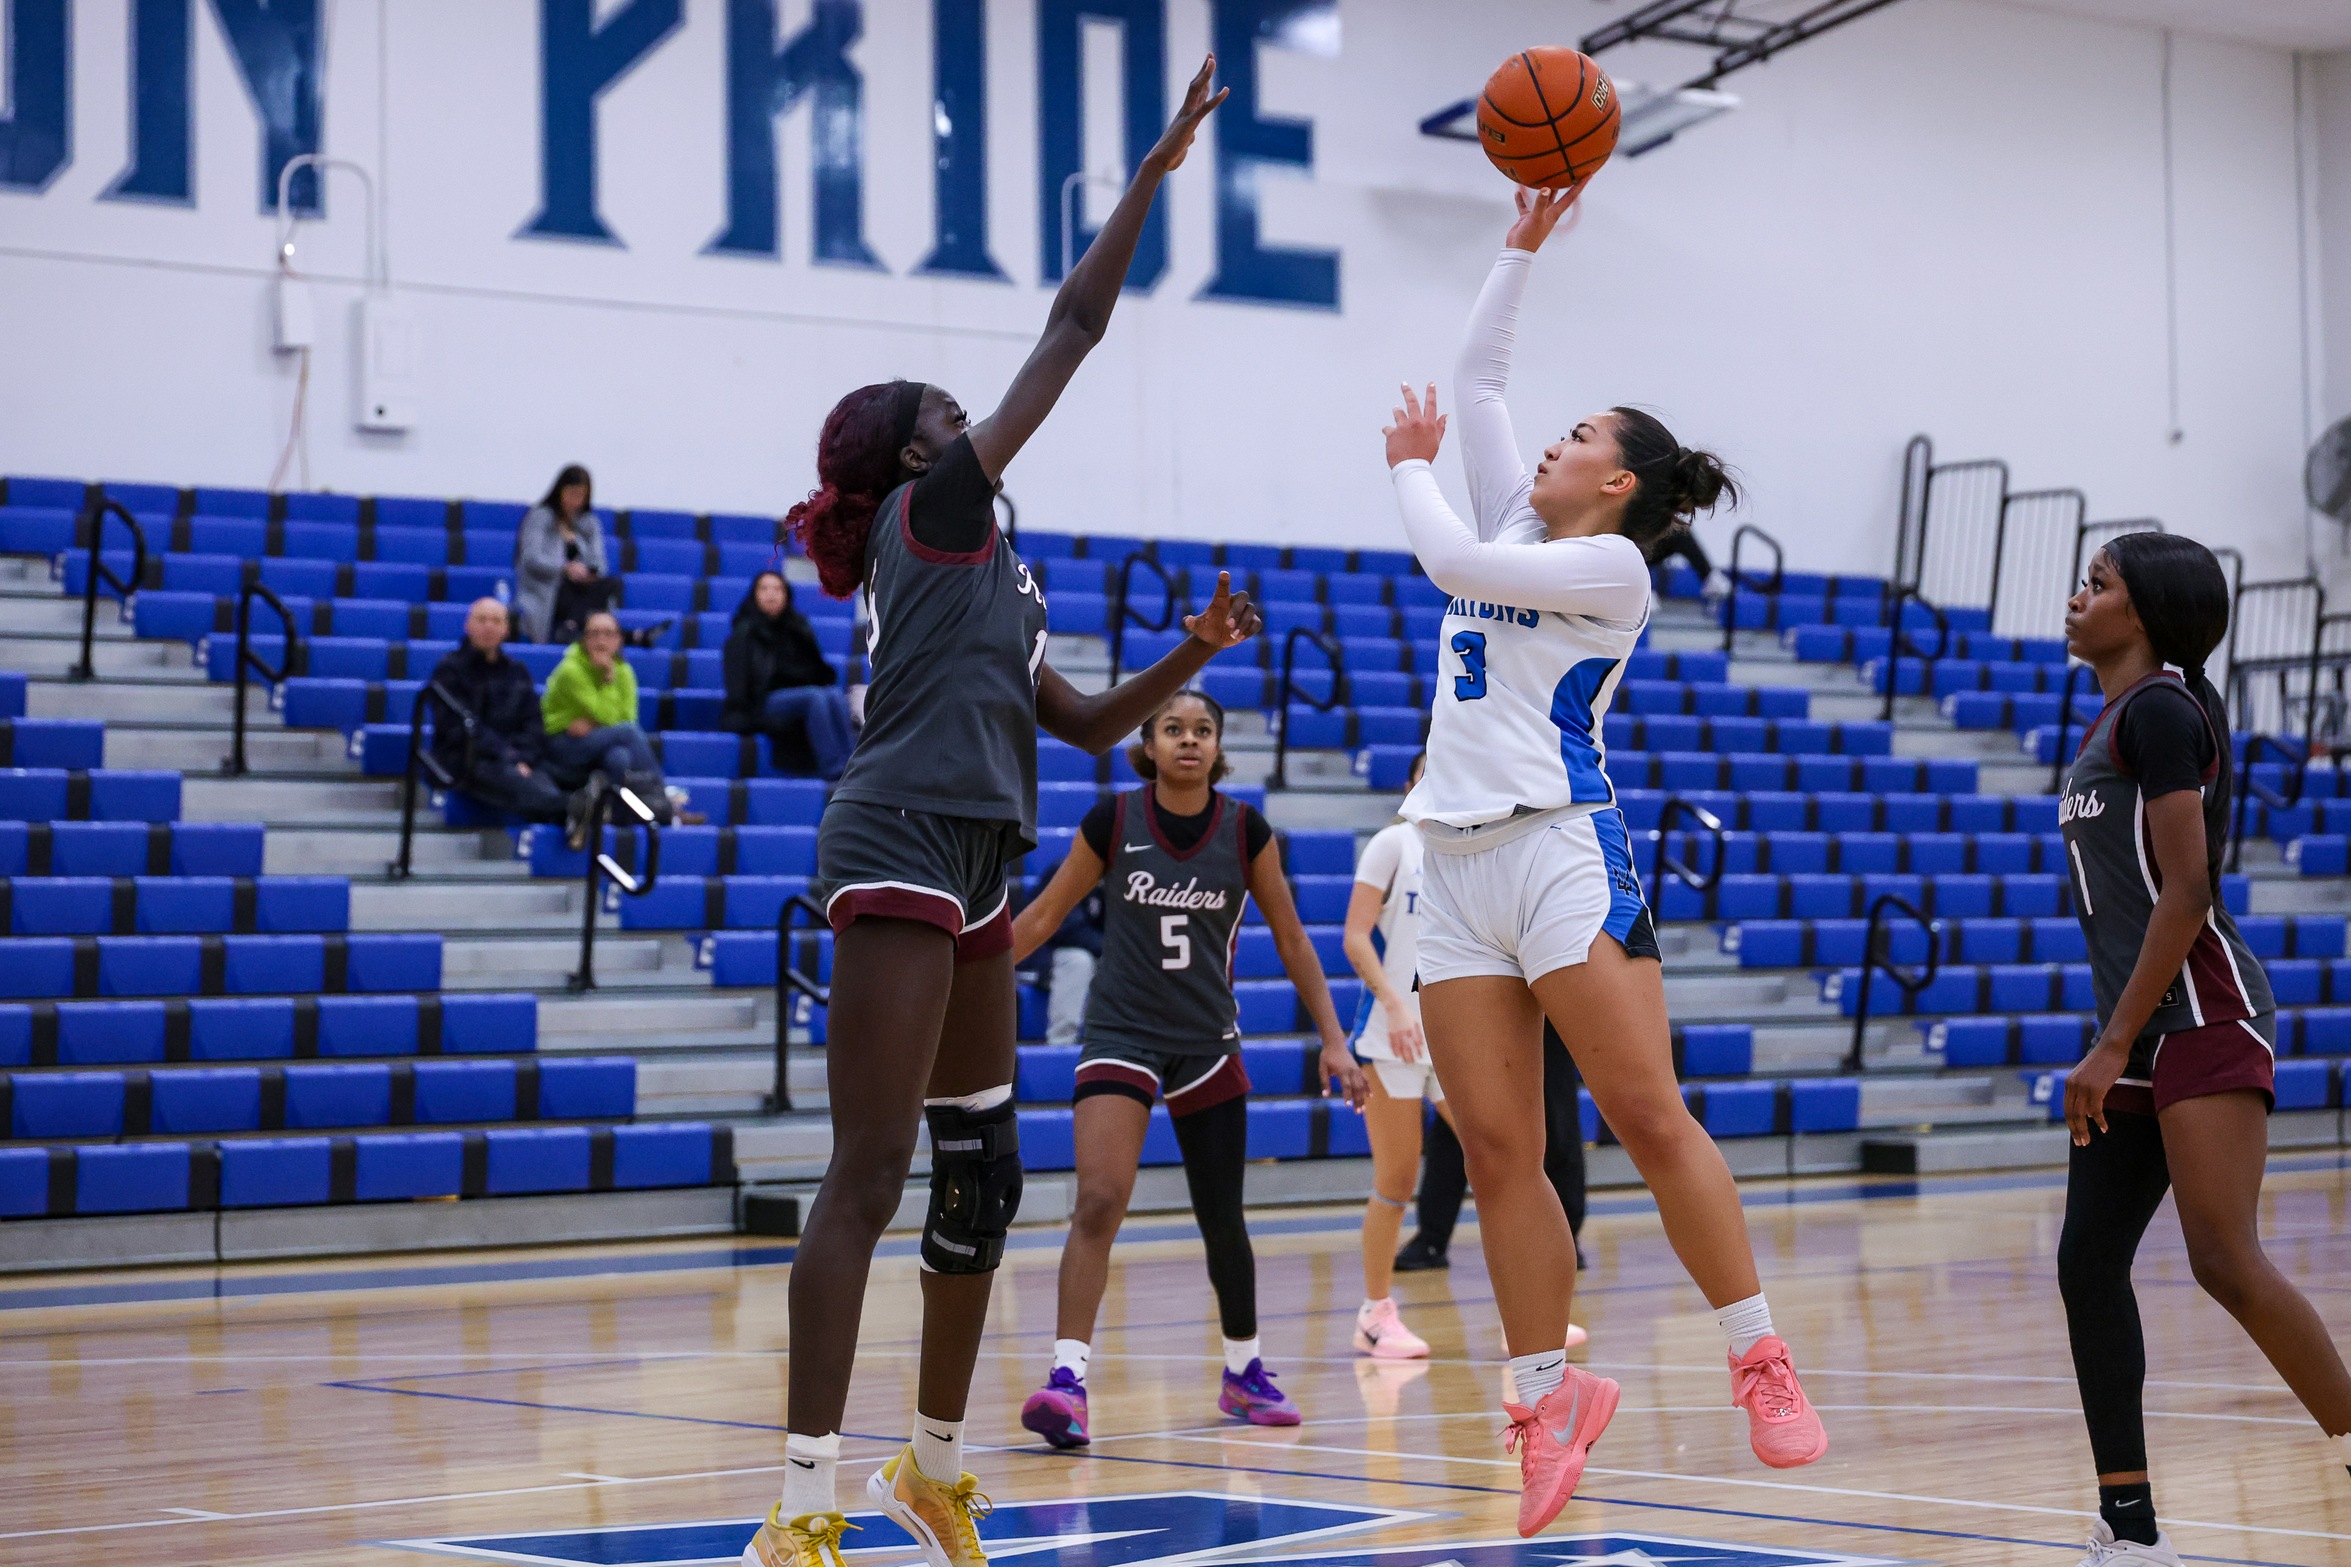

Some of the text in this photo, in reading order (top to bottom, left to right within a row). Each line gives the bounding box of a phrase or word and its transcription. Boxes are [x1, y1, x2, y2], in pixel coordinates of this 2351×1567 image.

[509, 0, 1342, 314] PRIDE
[1451, 630, 1487, 702] 3
[1123, 870, 1227, 909] Raiders
[2070, 839, 2094, 916] 1
[1160, 914, 1191, 970] 5
